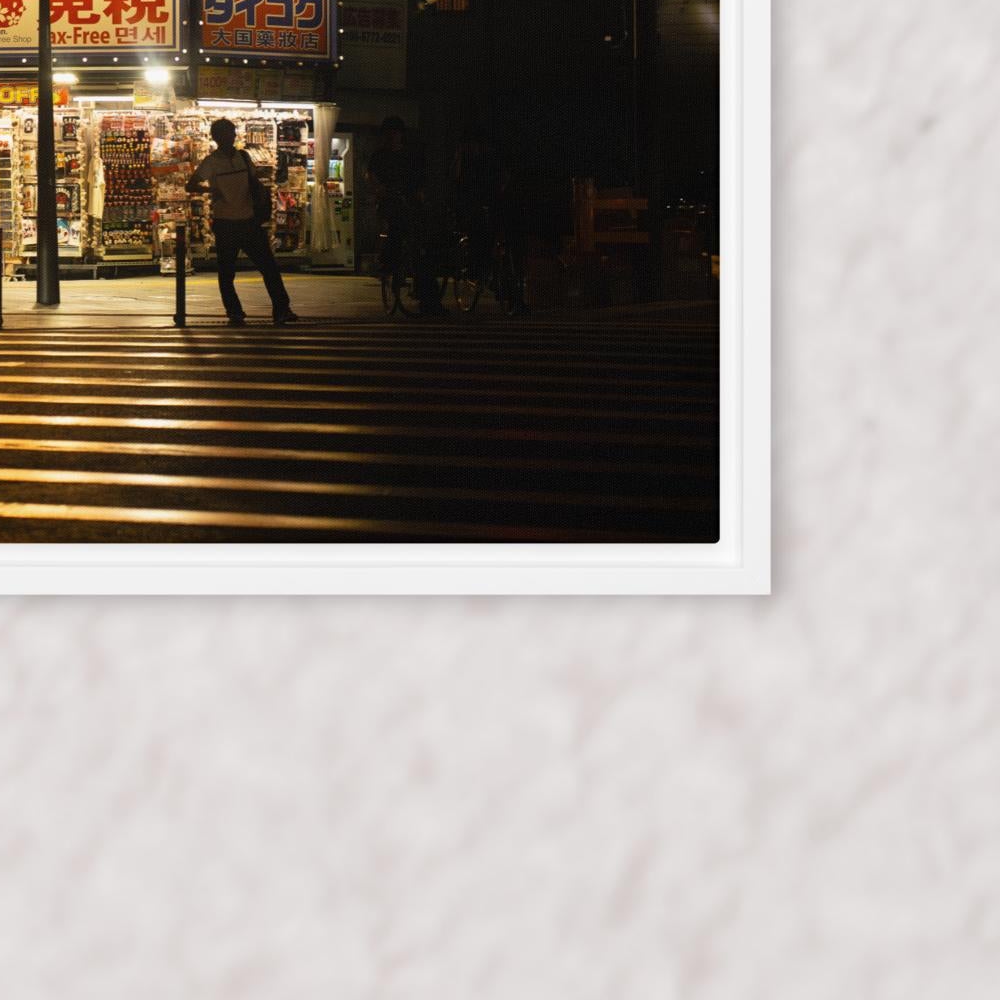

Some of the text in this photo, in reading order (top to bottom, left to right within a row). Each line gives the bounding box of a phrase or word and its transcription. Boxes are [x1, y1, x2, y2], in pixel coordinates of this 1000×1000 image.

[13, 36, 32, 45] Shop
[41, 26, 167, 45] ax-Free 면세
